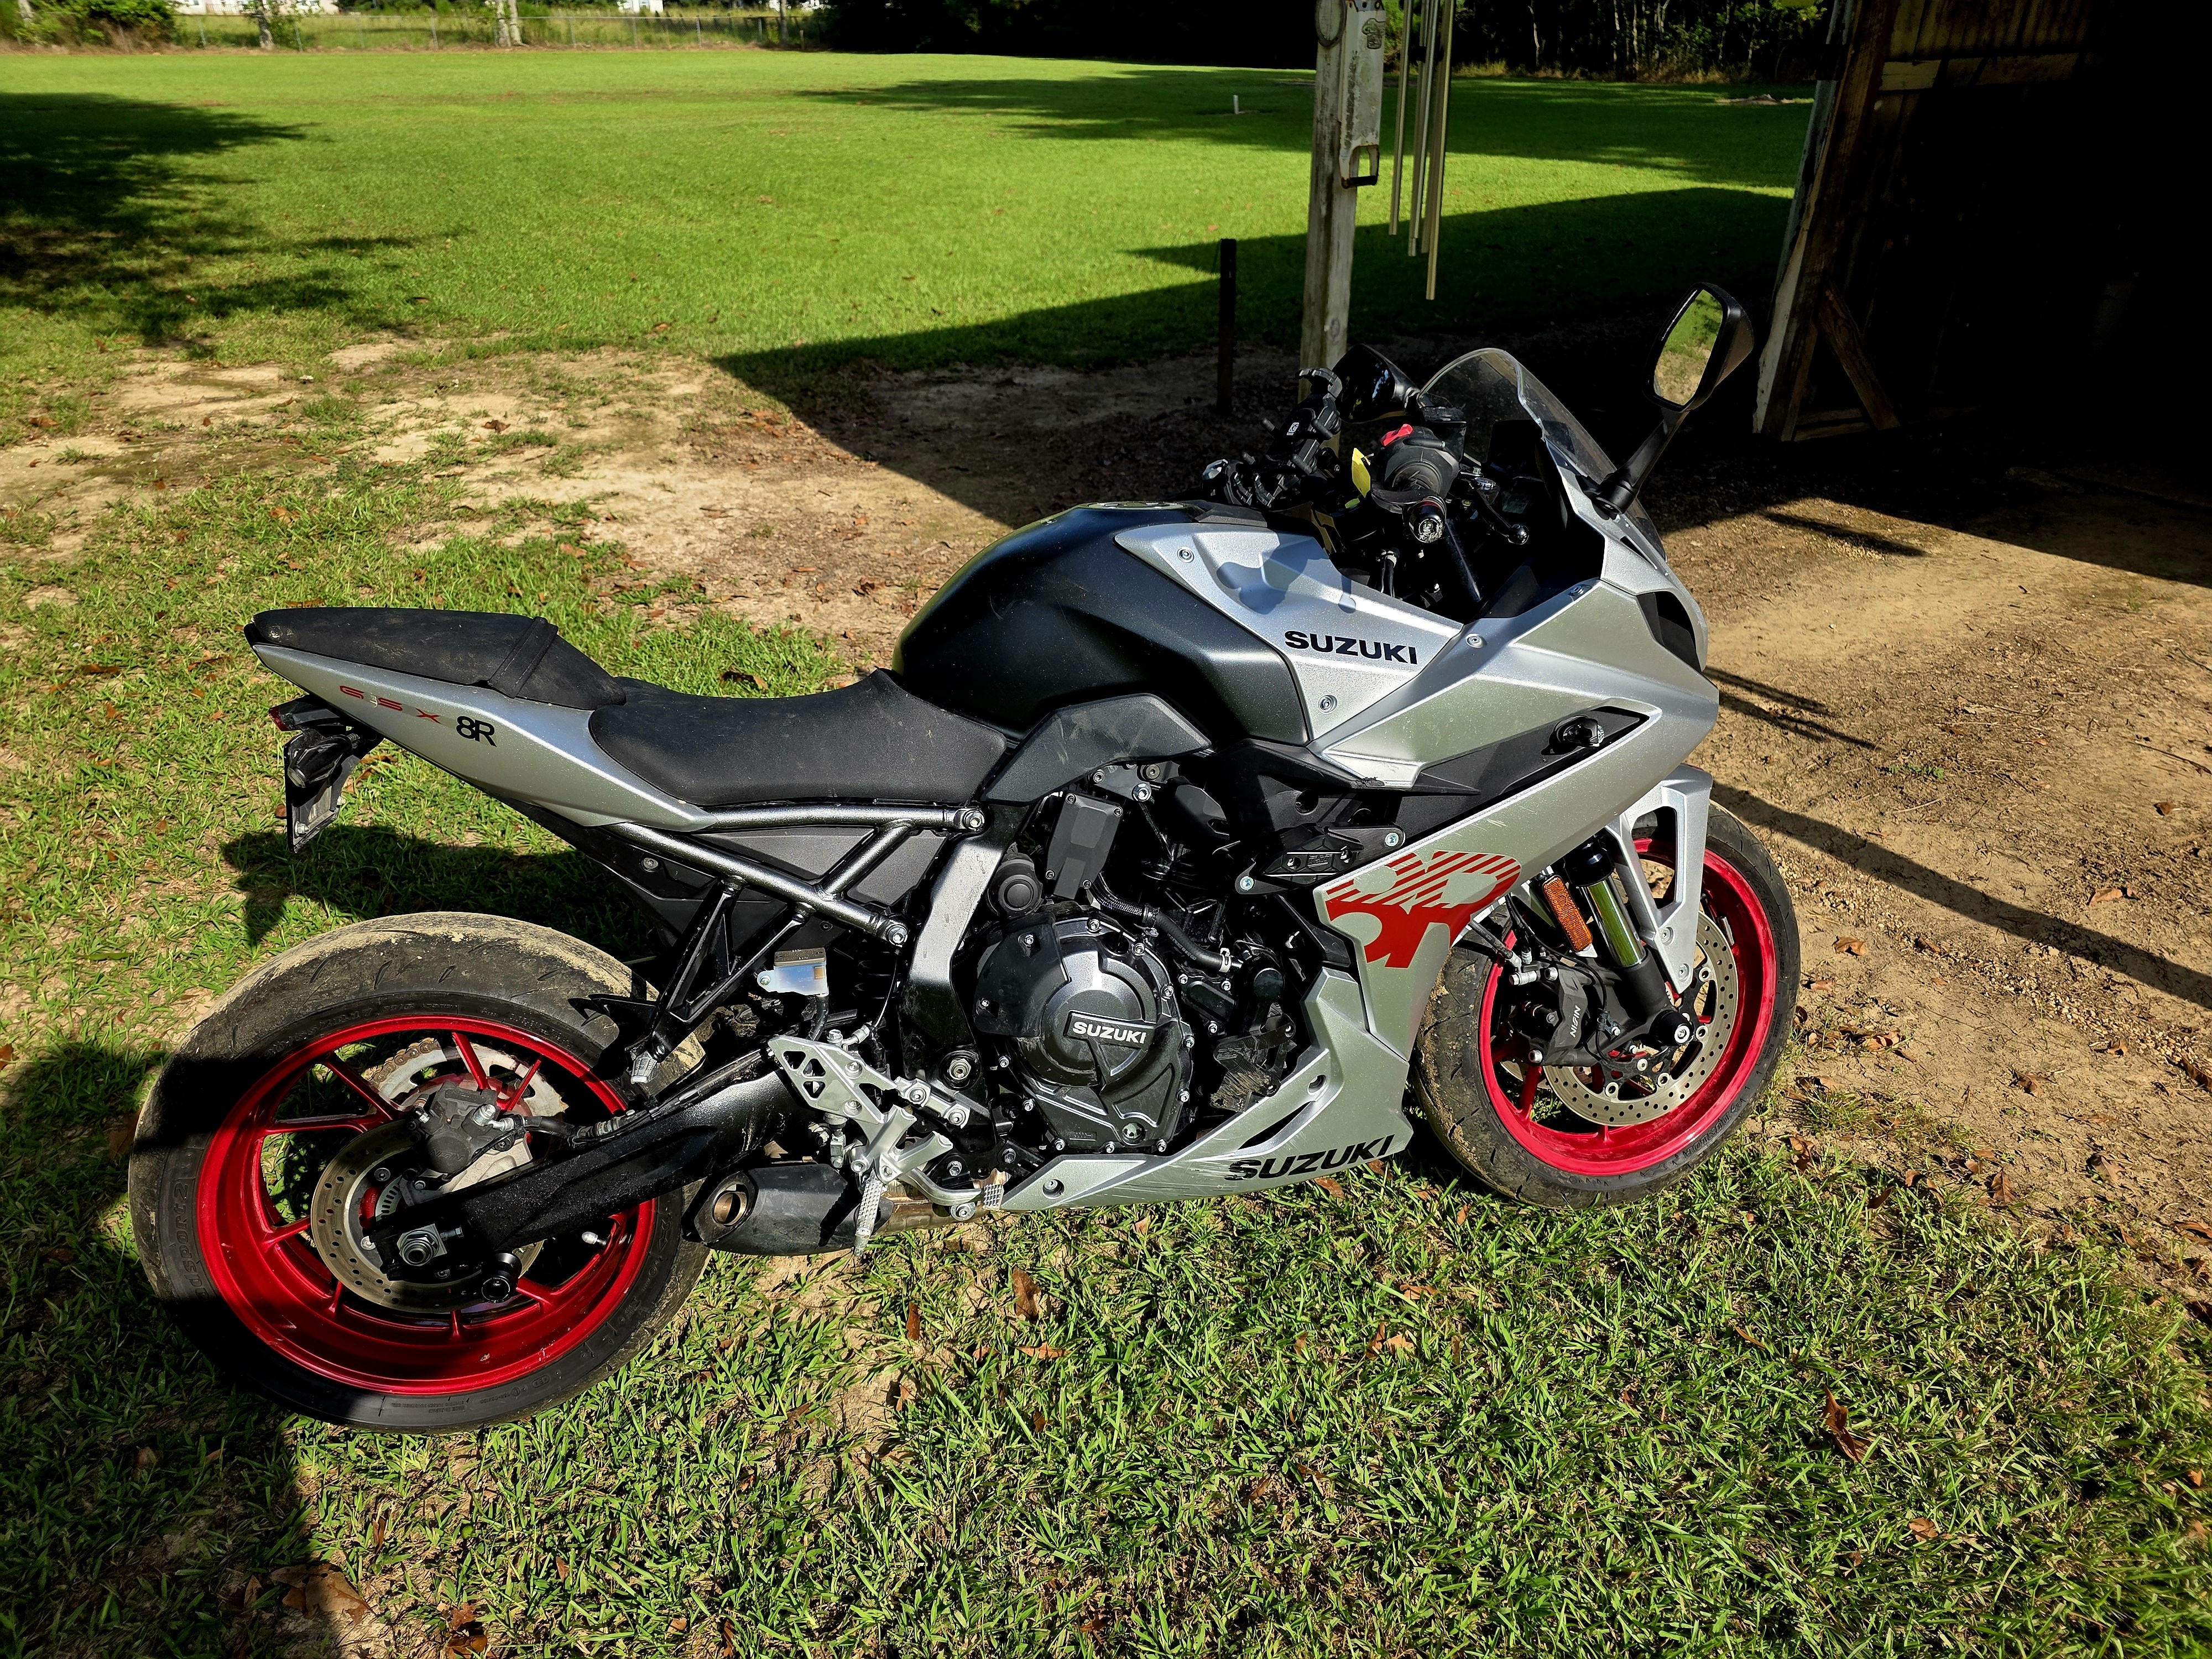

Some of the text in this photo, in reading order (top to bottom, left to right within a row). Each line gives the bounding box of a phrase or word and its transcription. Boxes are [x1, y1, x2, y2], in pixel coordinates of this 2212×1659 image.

[1284, 630, 1418, 665] SUZUKI
[456, 716, 497, 747] 8R
[1072, 1021, 1147, 1044] SUZUKI
[1224, 1134, 1395, 1181] SUZUKI
